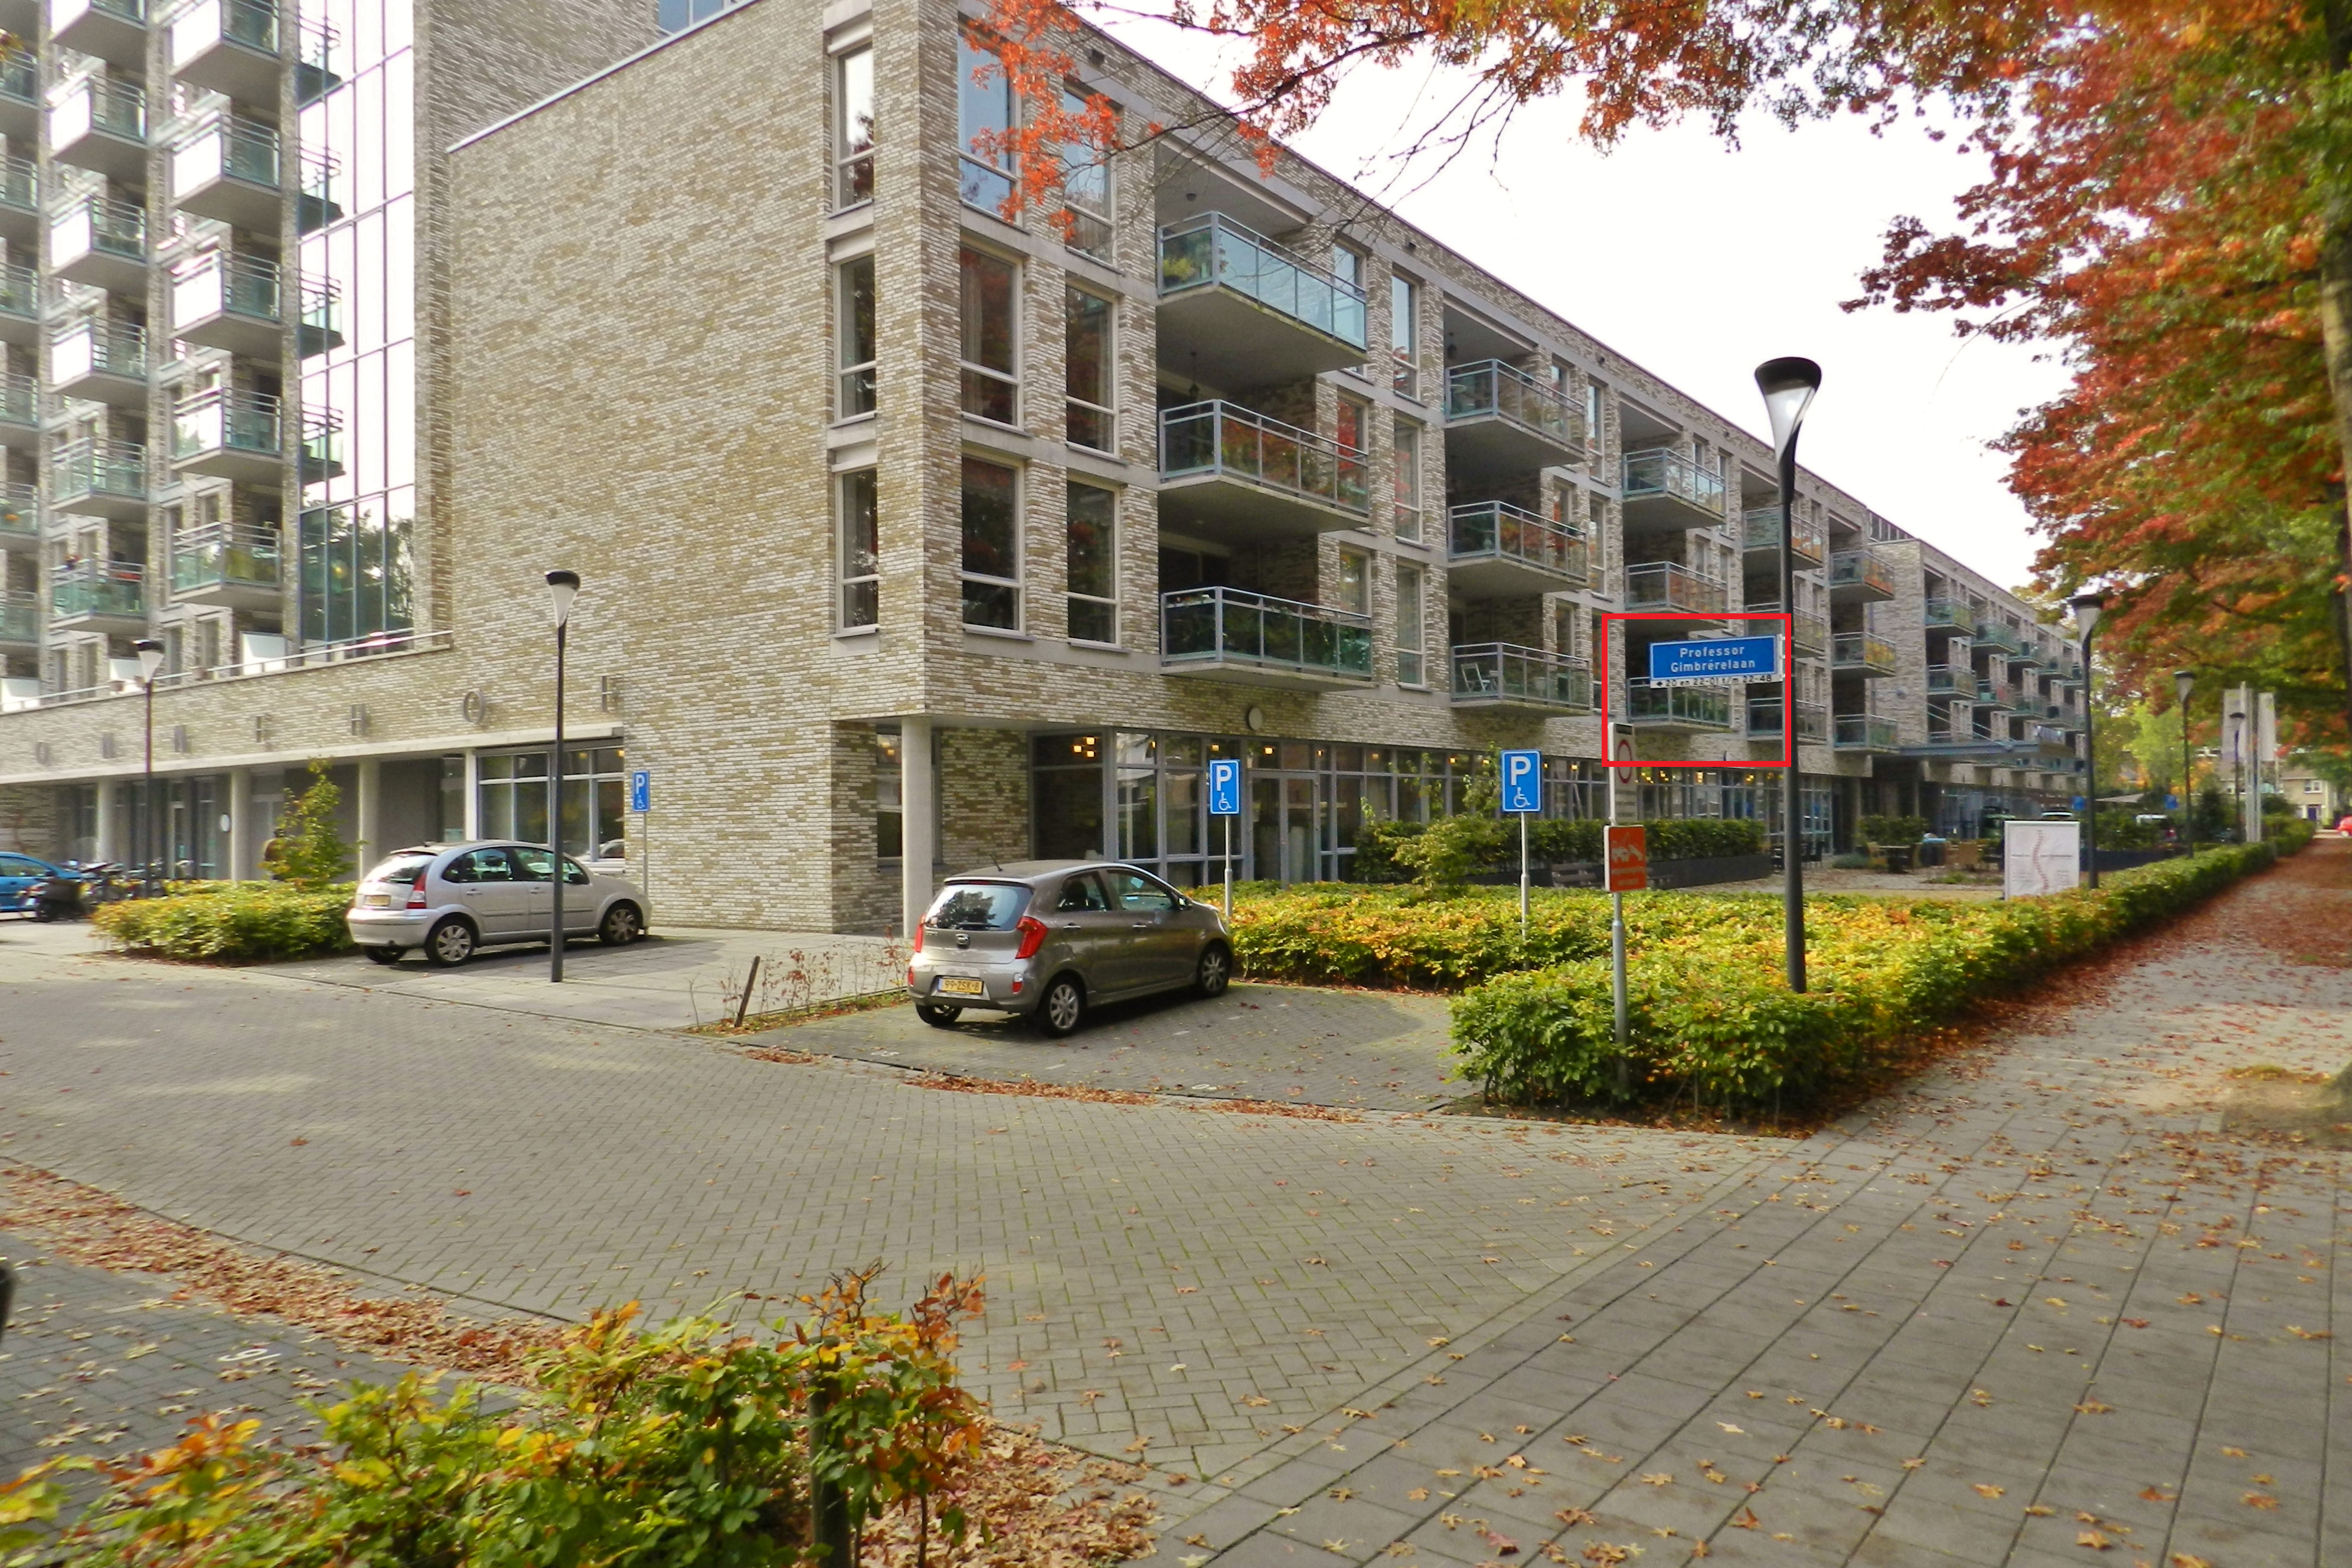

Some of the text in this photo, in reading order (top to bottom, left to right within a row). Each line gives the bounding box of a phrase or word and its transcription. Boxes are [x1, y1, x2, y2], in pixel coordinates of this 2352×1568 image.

[1680, 646, 1745, 658] Professor
[1216, 765, 1233, 792] P
[1510, 756, 1532, 786] P
[636, 774, 645, 794] P
